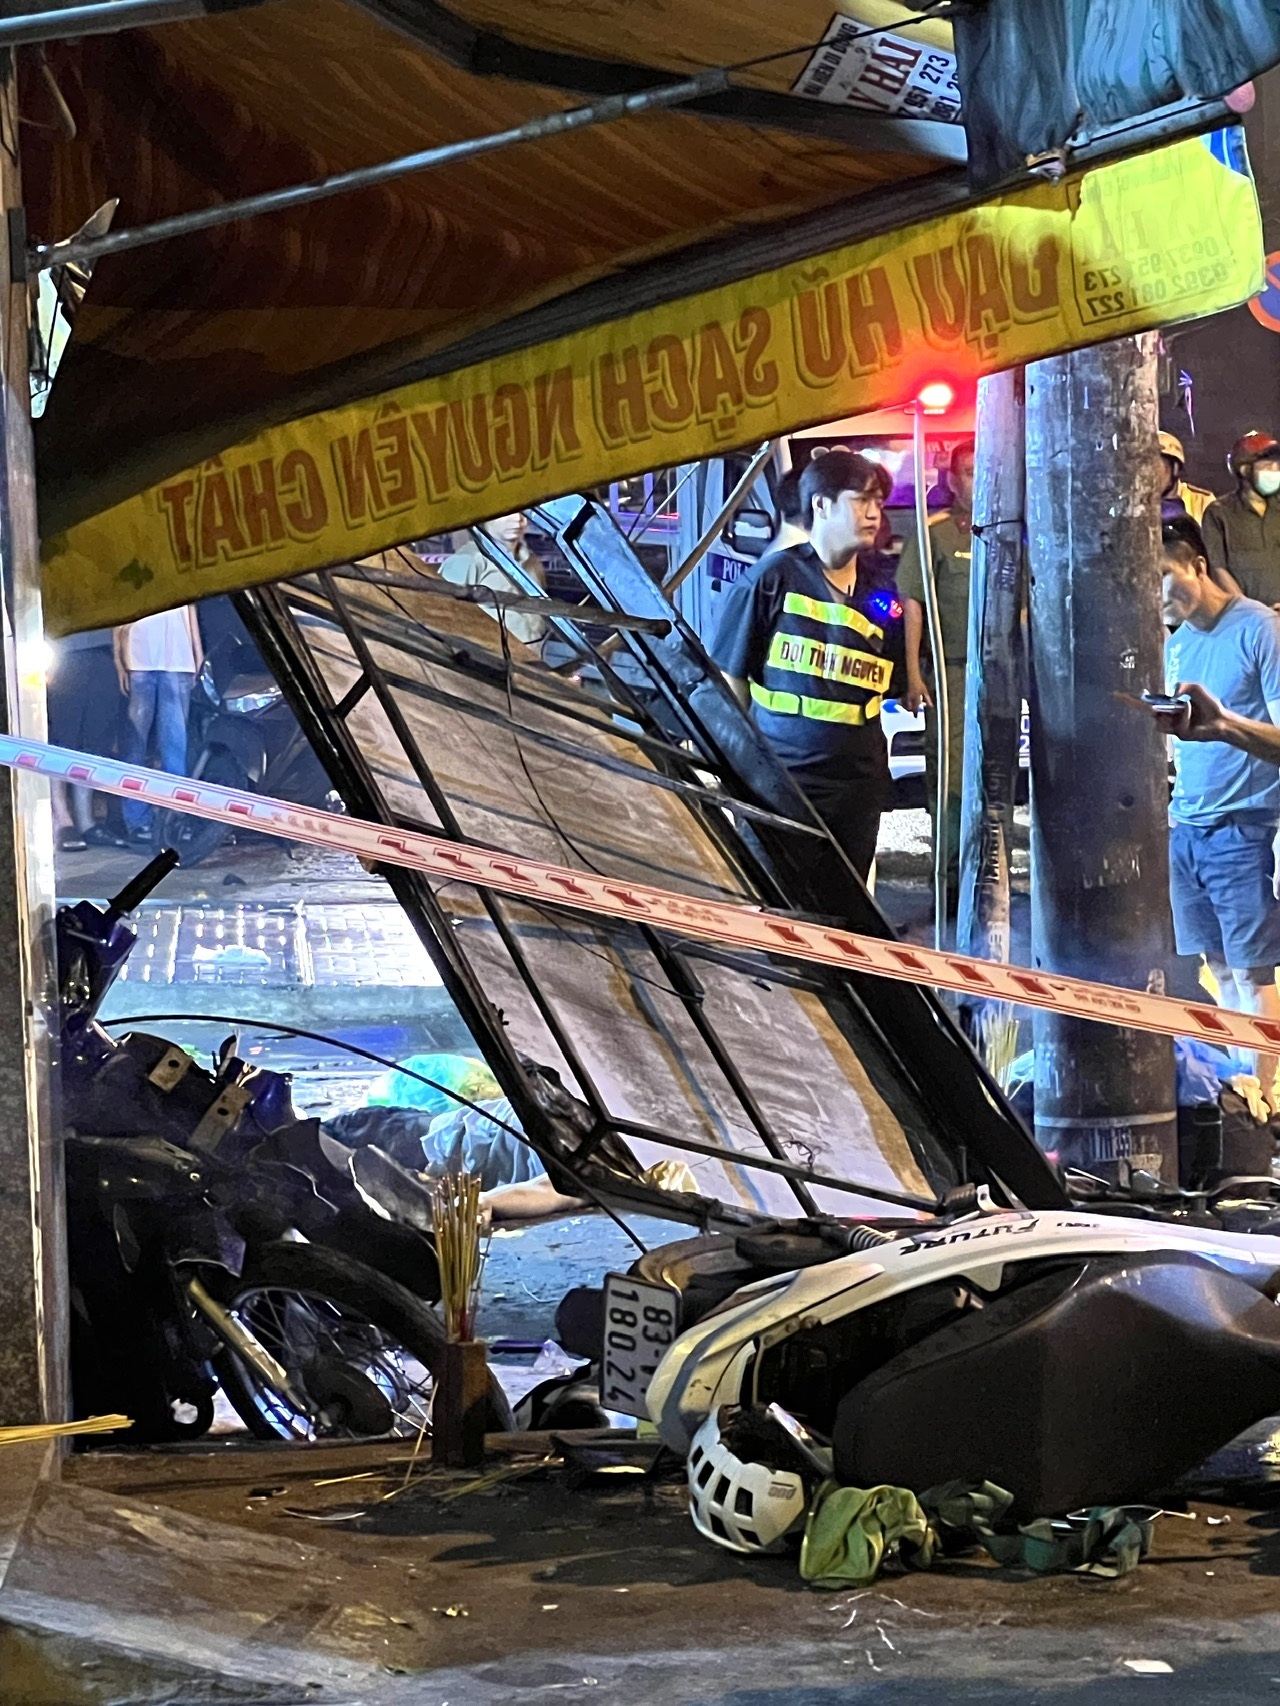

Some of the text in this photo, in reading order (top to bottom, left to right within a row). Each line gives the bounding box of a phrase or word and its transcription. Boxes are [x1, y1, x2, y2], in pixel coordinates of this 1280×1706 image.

[919, 53, 950, 84] 273
[900, 1218, 1040, 1255] FUTURE
[607, 1290, 639, 1402] 180.24
[640, 1306, 673, 1394] 83-
